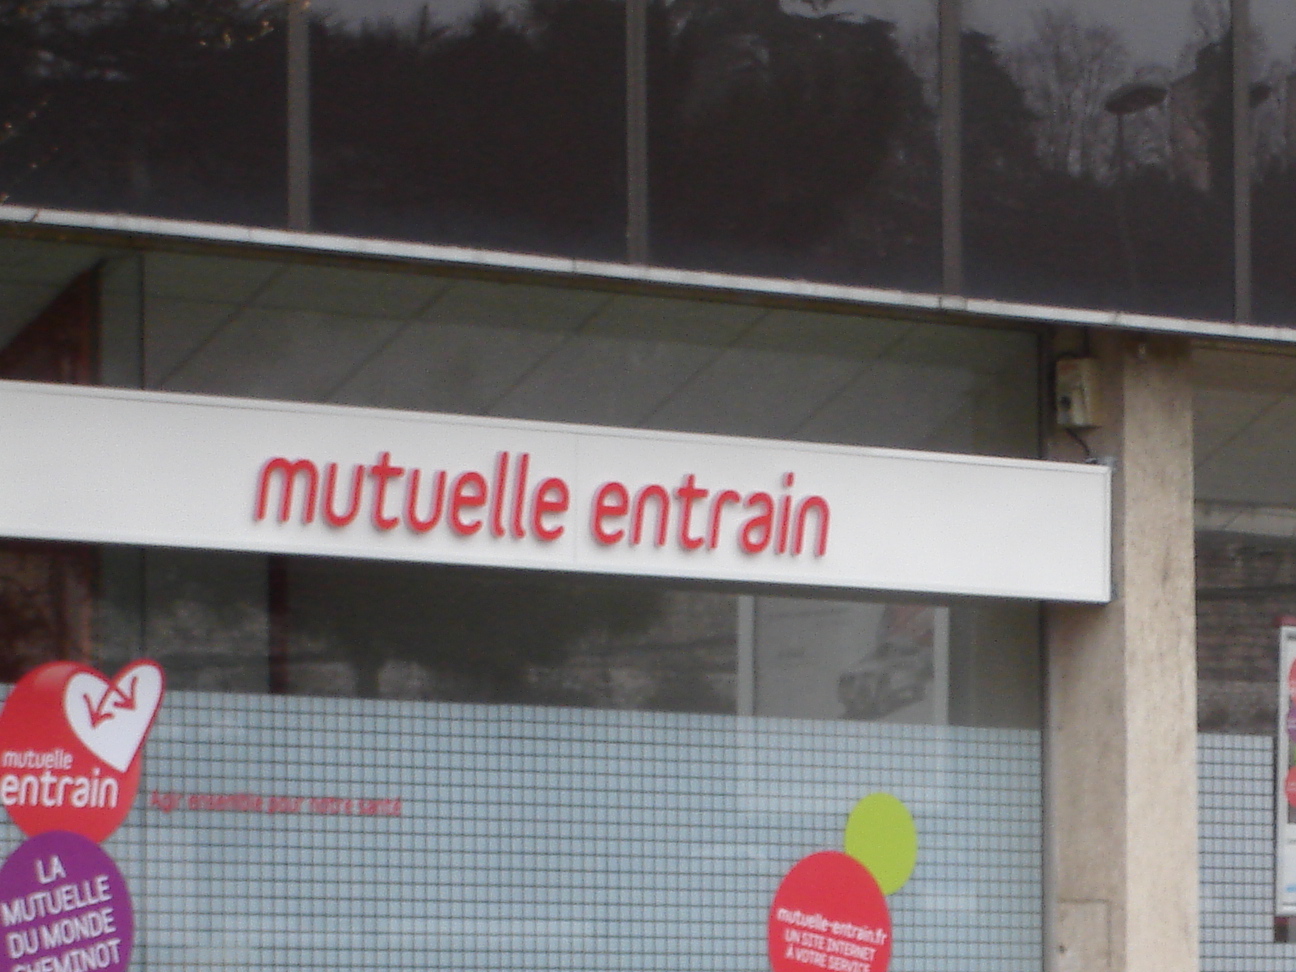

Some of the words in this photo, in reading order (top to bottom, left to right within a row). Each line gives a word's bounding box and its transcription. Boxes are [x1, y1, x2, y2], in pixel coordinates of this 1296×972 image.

[254, 451, 569, 542] mutuelle
[591, 472, 831, 557] entrain
[2, 748, 74, 770] mutuelle
[1, 767, 119, 809] entrain
[36, 855, 67, 885] LA
[1, 874, 112, 927] MUTUELLE
[6, 927, 40, 960] DU
[41, 907, 117, 950] MONDE
[827, 938, 876, 962] INTERNET
